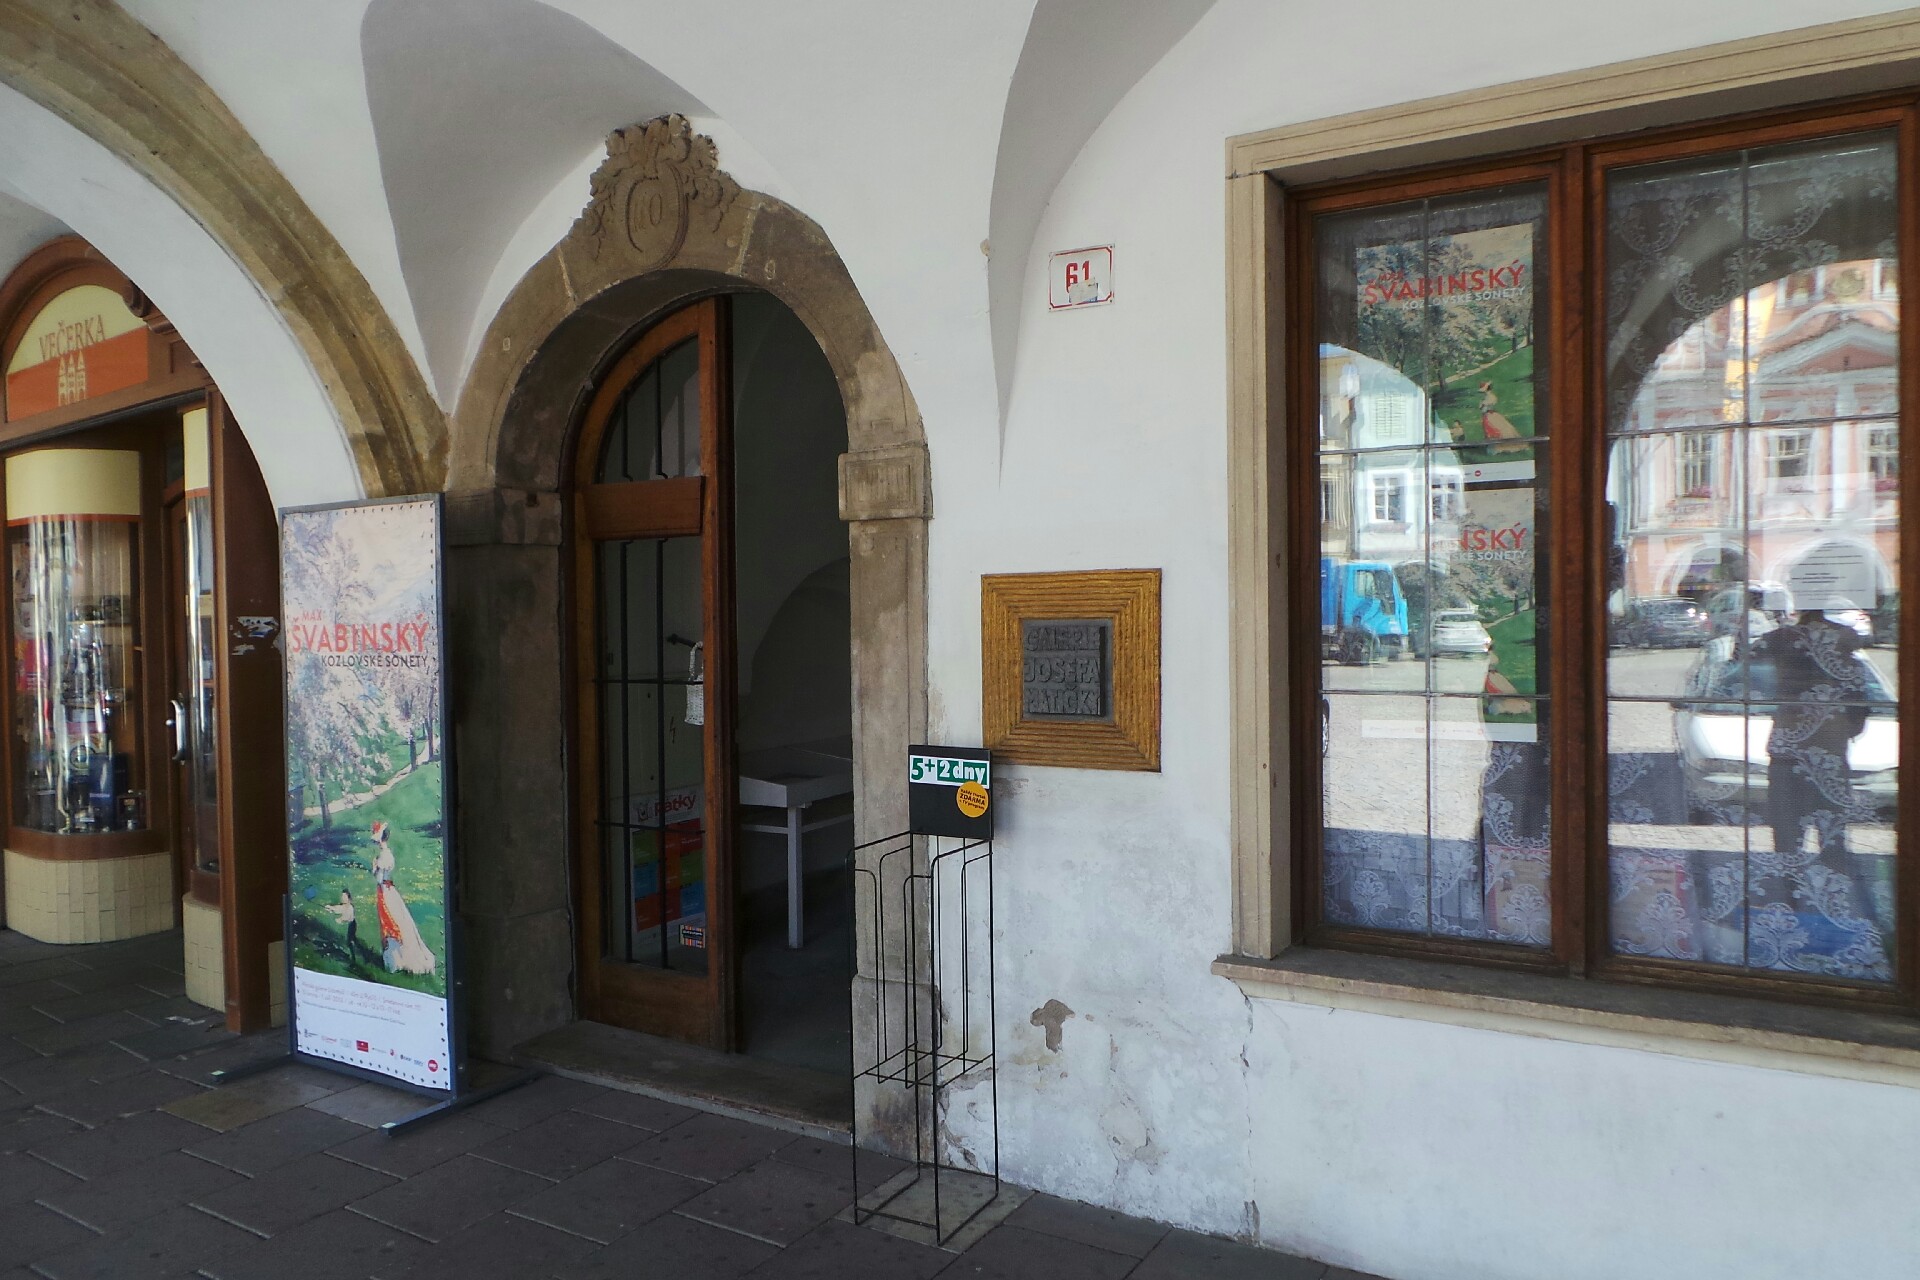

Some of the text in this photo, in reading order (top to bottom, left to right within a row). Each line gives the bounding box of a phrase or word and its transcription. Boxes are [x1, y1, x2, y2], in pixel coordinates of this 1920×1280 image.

[1065, 260, 1090, 294] 61
[1364, 259, 1526, 306] ŠVABINSKÝ
[1402, 287, 1526, 311] KOZOVSKÉ SONETY
[38, 314, 107, 362] VEČERKA
[1477, 550, 1527, 561] SONETY
[301, 610, 322, 622] MAX
[292, 613, 430, 654] ŠVABINSKÝ
[385, 654, 428, 668] SONETY
[1024, 657, 1100, 684] JOSEFA
[952, 761, 986, 785] dny
[959, 793, 985, 806] ZDARMA
